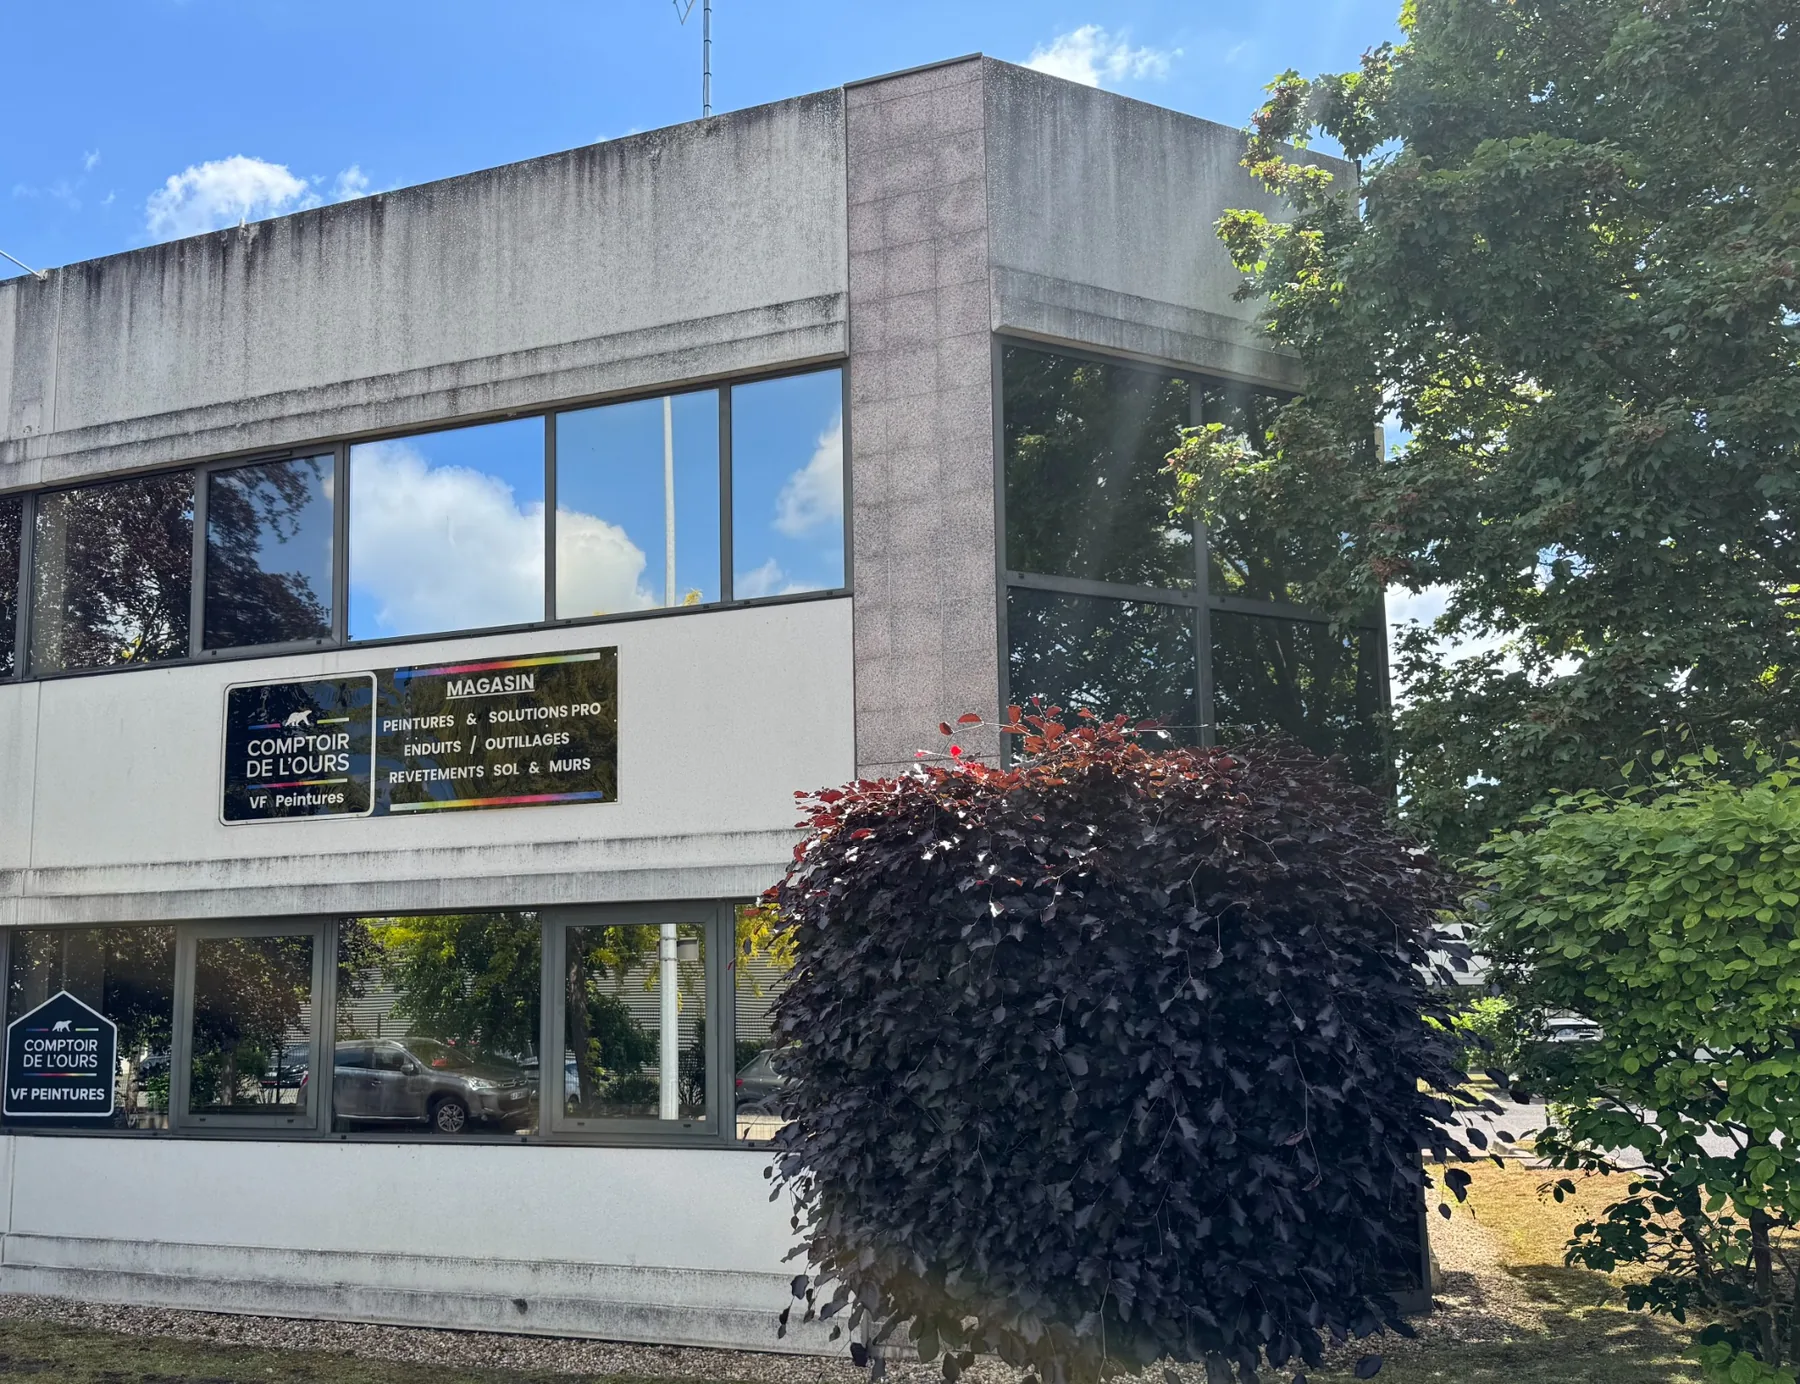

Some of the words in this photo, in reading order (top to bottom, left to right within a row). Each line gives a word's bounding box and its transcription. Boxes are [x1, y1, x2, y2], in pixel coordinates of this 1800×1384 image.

[447, 673, 535, 697] MAGASIN
[383, 715, 455, 732] PEINTURES
[466, 713, 477, 725] &
[489, 705, 568, 723] SOLUTIONS
[571, 702, 601, 717] PRO
[247, 733, 350, 756] COMPTOIR
[404, 740, 462, 756] ENDUITS
[470, 735, 477, 754] /
[485, 732, 570, 750] OUTILLAGES
[246, 759, 273, 778] DE
[279, 753, 350, 775] L'OURS
[389, 765, 485, 783] REVETEMENTS
[493, 763, 520, 776] SOL
[529, 761, 540, 774] &
[549, 757, 591, 773] MURS
[249, 796, 268, 809] VF
[275, 792, 345, 807] Peintures
[24, 1039, 98, 1052] COMPTOIR
[23, 1054, 43, 1068] DE
[47, 1054, 98, 1068] L'OURS
[10, 1088, 28, 1100] VF
[31, 1088, 105, 1100] PEINTURES
